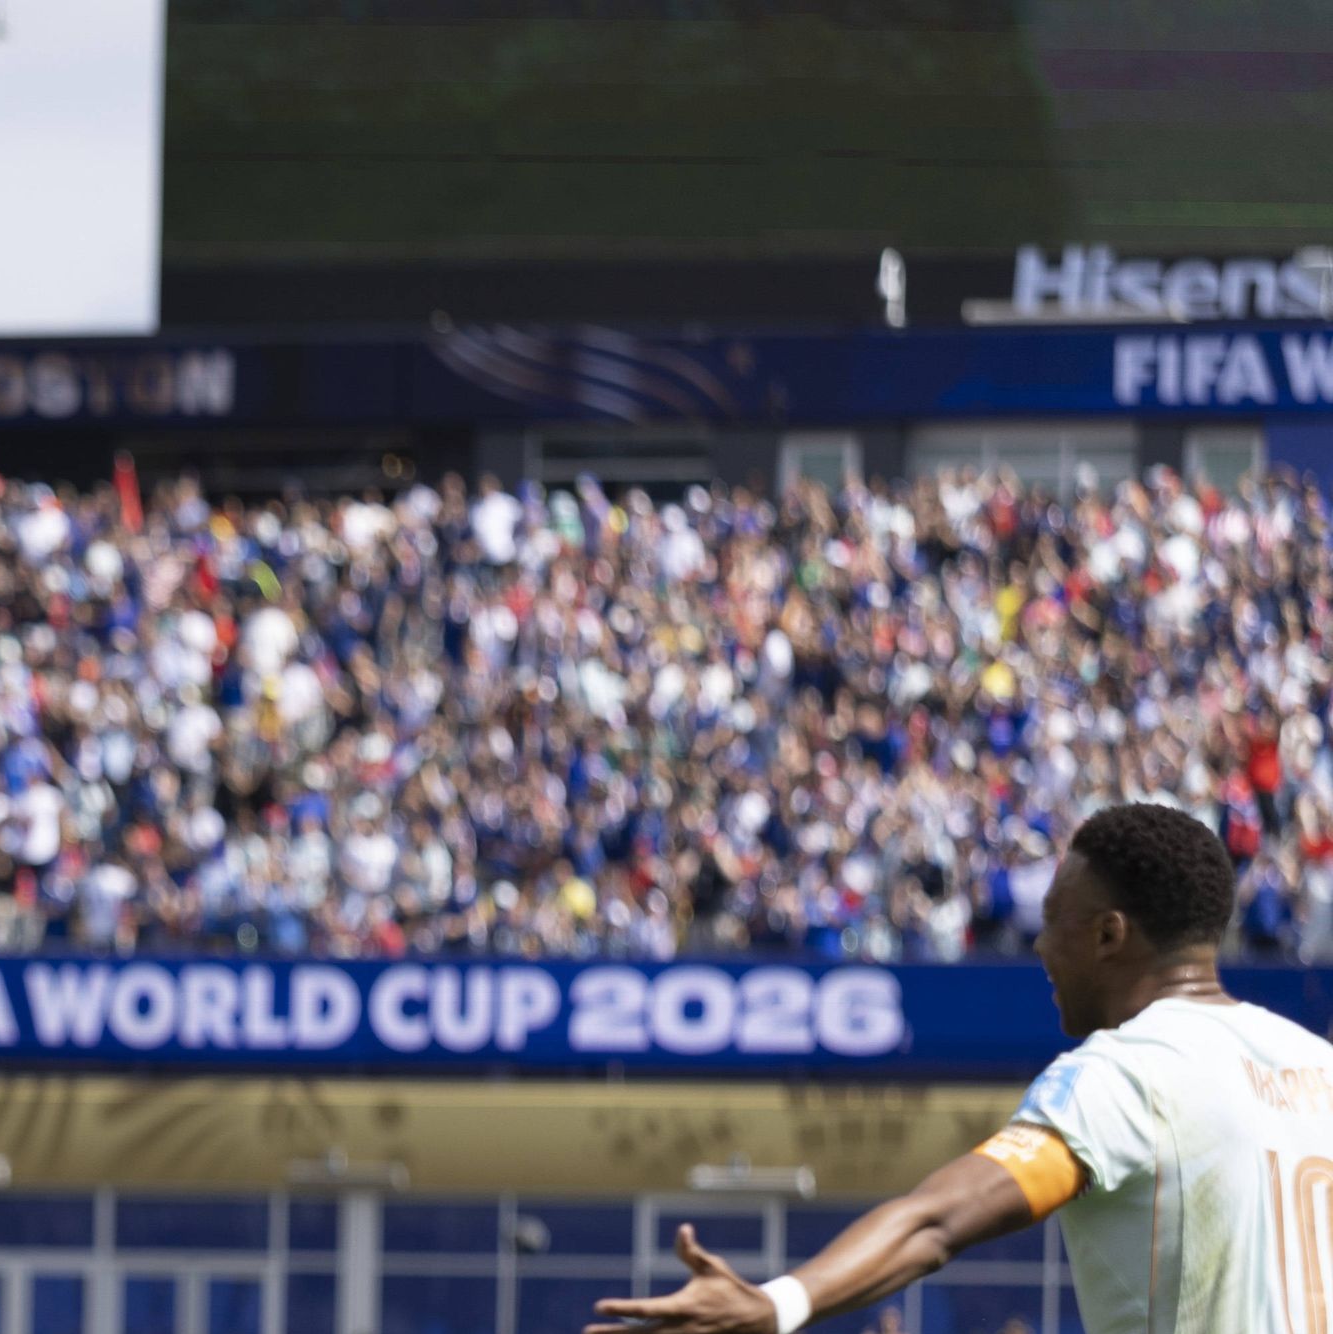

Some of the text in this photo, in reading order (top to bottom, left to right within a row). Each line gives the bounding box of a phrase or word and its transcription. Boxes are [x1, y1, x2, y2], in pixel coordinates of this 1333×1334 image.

[1113, 334, 1278, 406] FIFA
[23, 962, 362, 1051] WORLD
[367, 963, 561, 1053] CUP
[567, 964, 905, 1057] 2026
